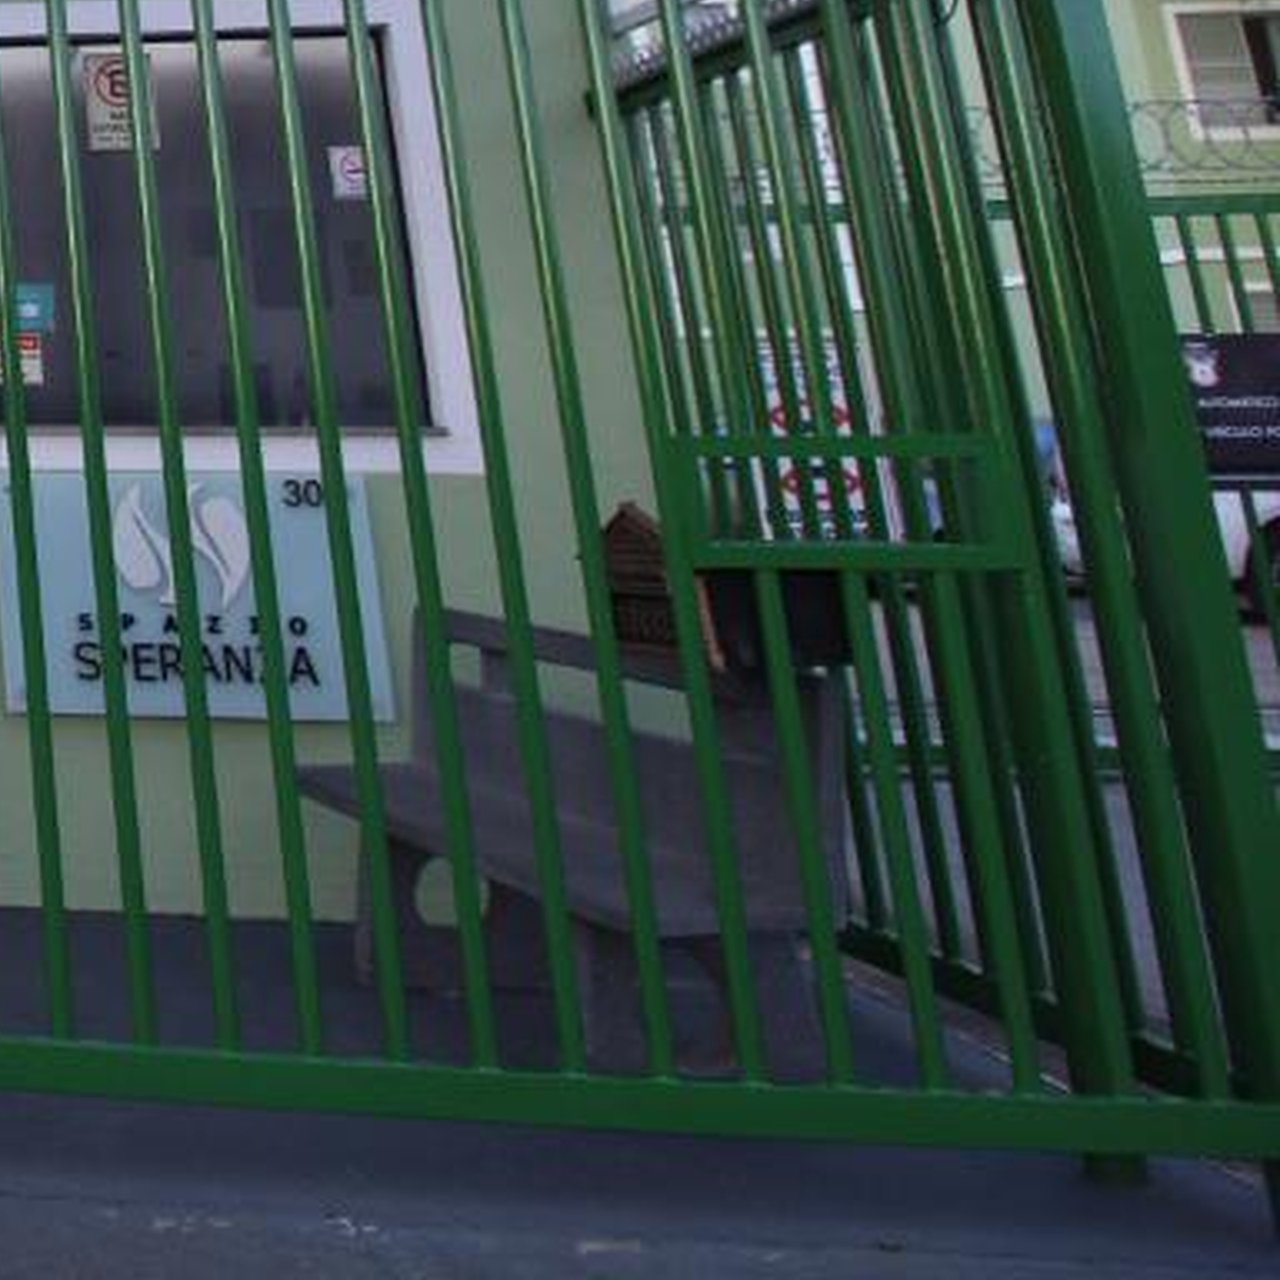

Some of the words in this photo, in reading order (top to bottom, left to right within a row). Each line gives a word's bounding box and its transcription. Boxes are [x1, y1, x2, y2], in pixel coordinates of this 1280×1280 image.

[281, 478, 321, 508] 30
[77, 612, 308, 637] SPAZIO
[73, 641, 320, 687] SERANA
